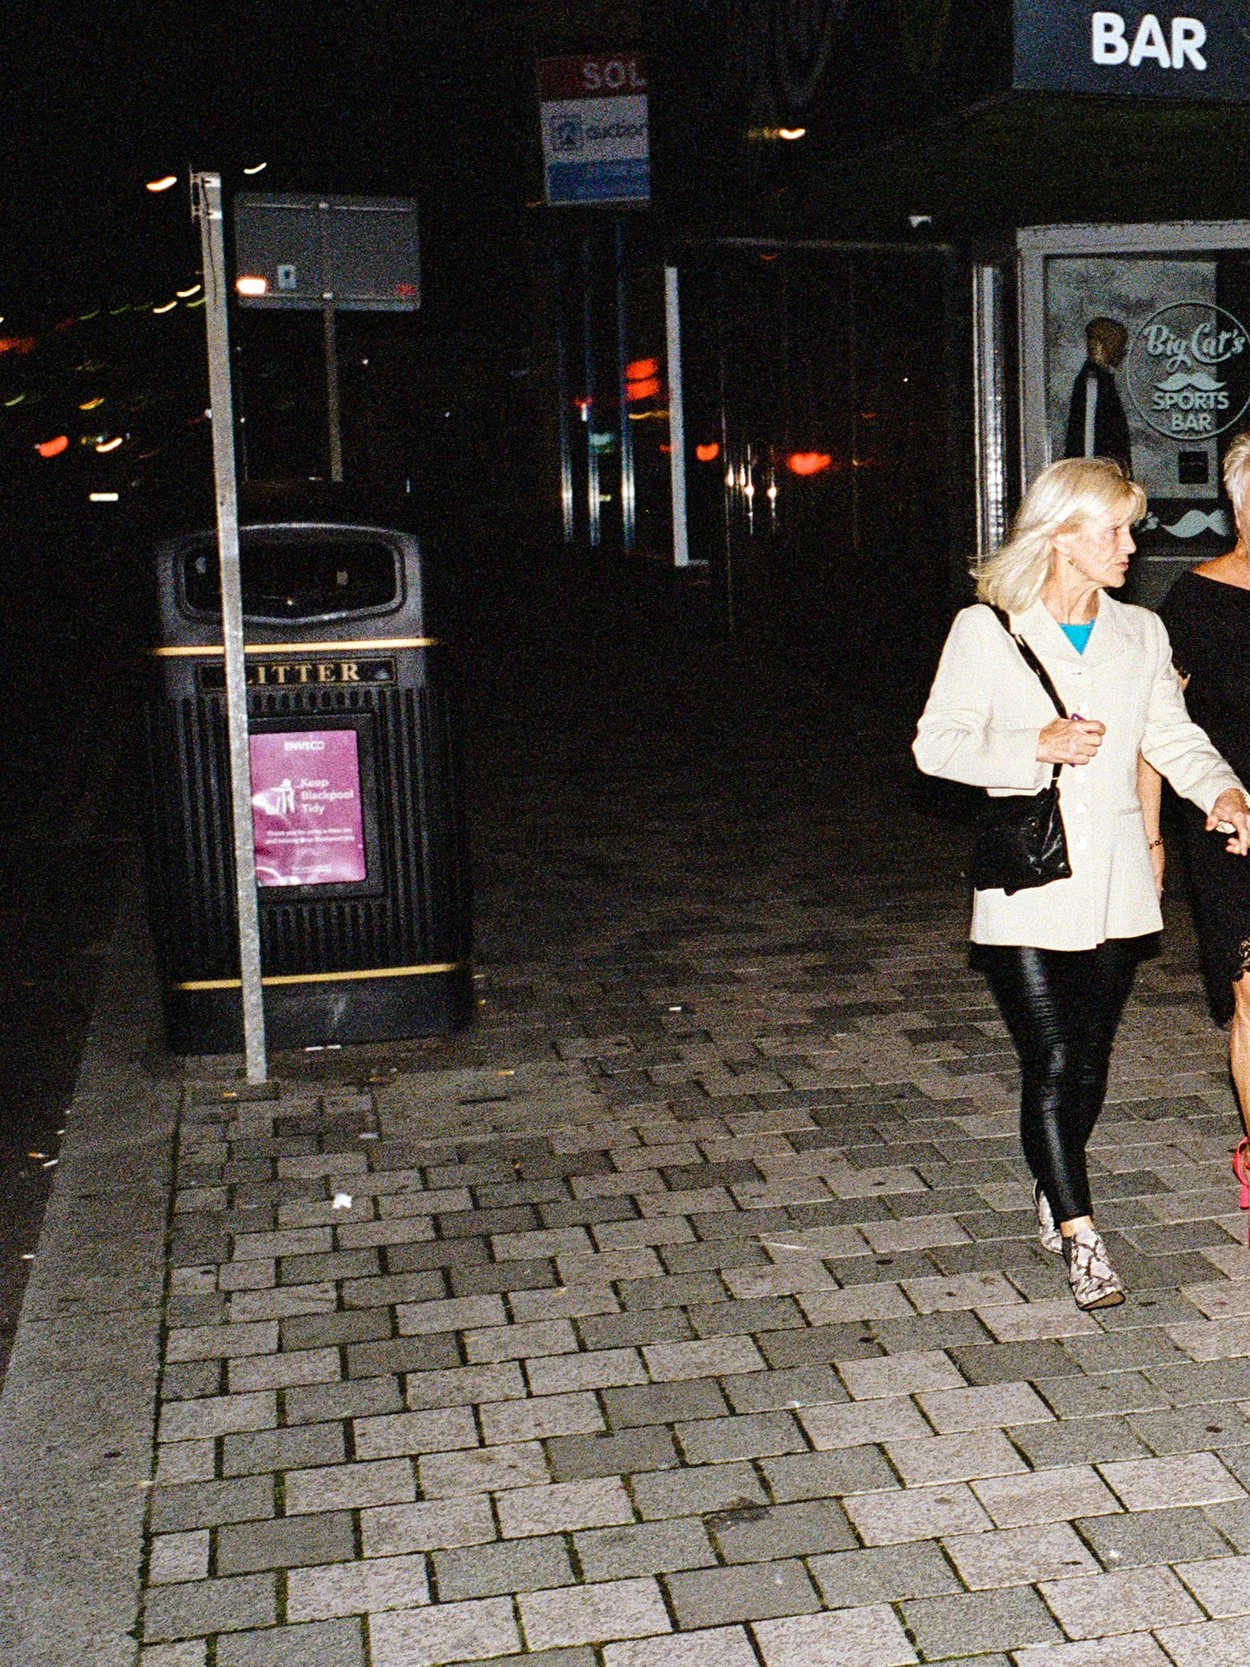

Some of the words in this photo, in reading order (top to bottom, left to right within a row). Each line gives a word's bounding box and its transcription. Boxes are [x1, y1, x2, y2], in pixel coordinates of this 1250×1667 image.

[1092, 11, 1207, 71] BAR
[1143, 325, 1192, 370] Big
[1192, 322, 1246, 364] Cat's
[1153, 391, 1230, 410] SPORTS
[1171, 411, 1213, 432] BAR
[247, 662, 360, 685] ITTER
[300, 778, 329, 790] Keep
[301, 790, 354, 804] Blackpool
[301, 803, 325, 817] Tidy
